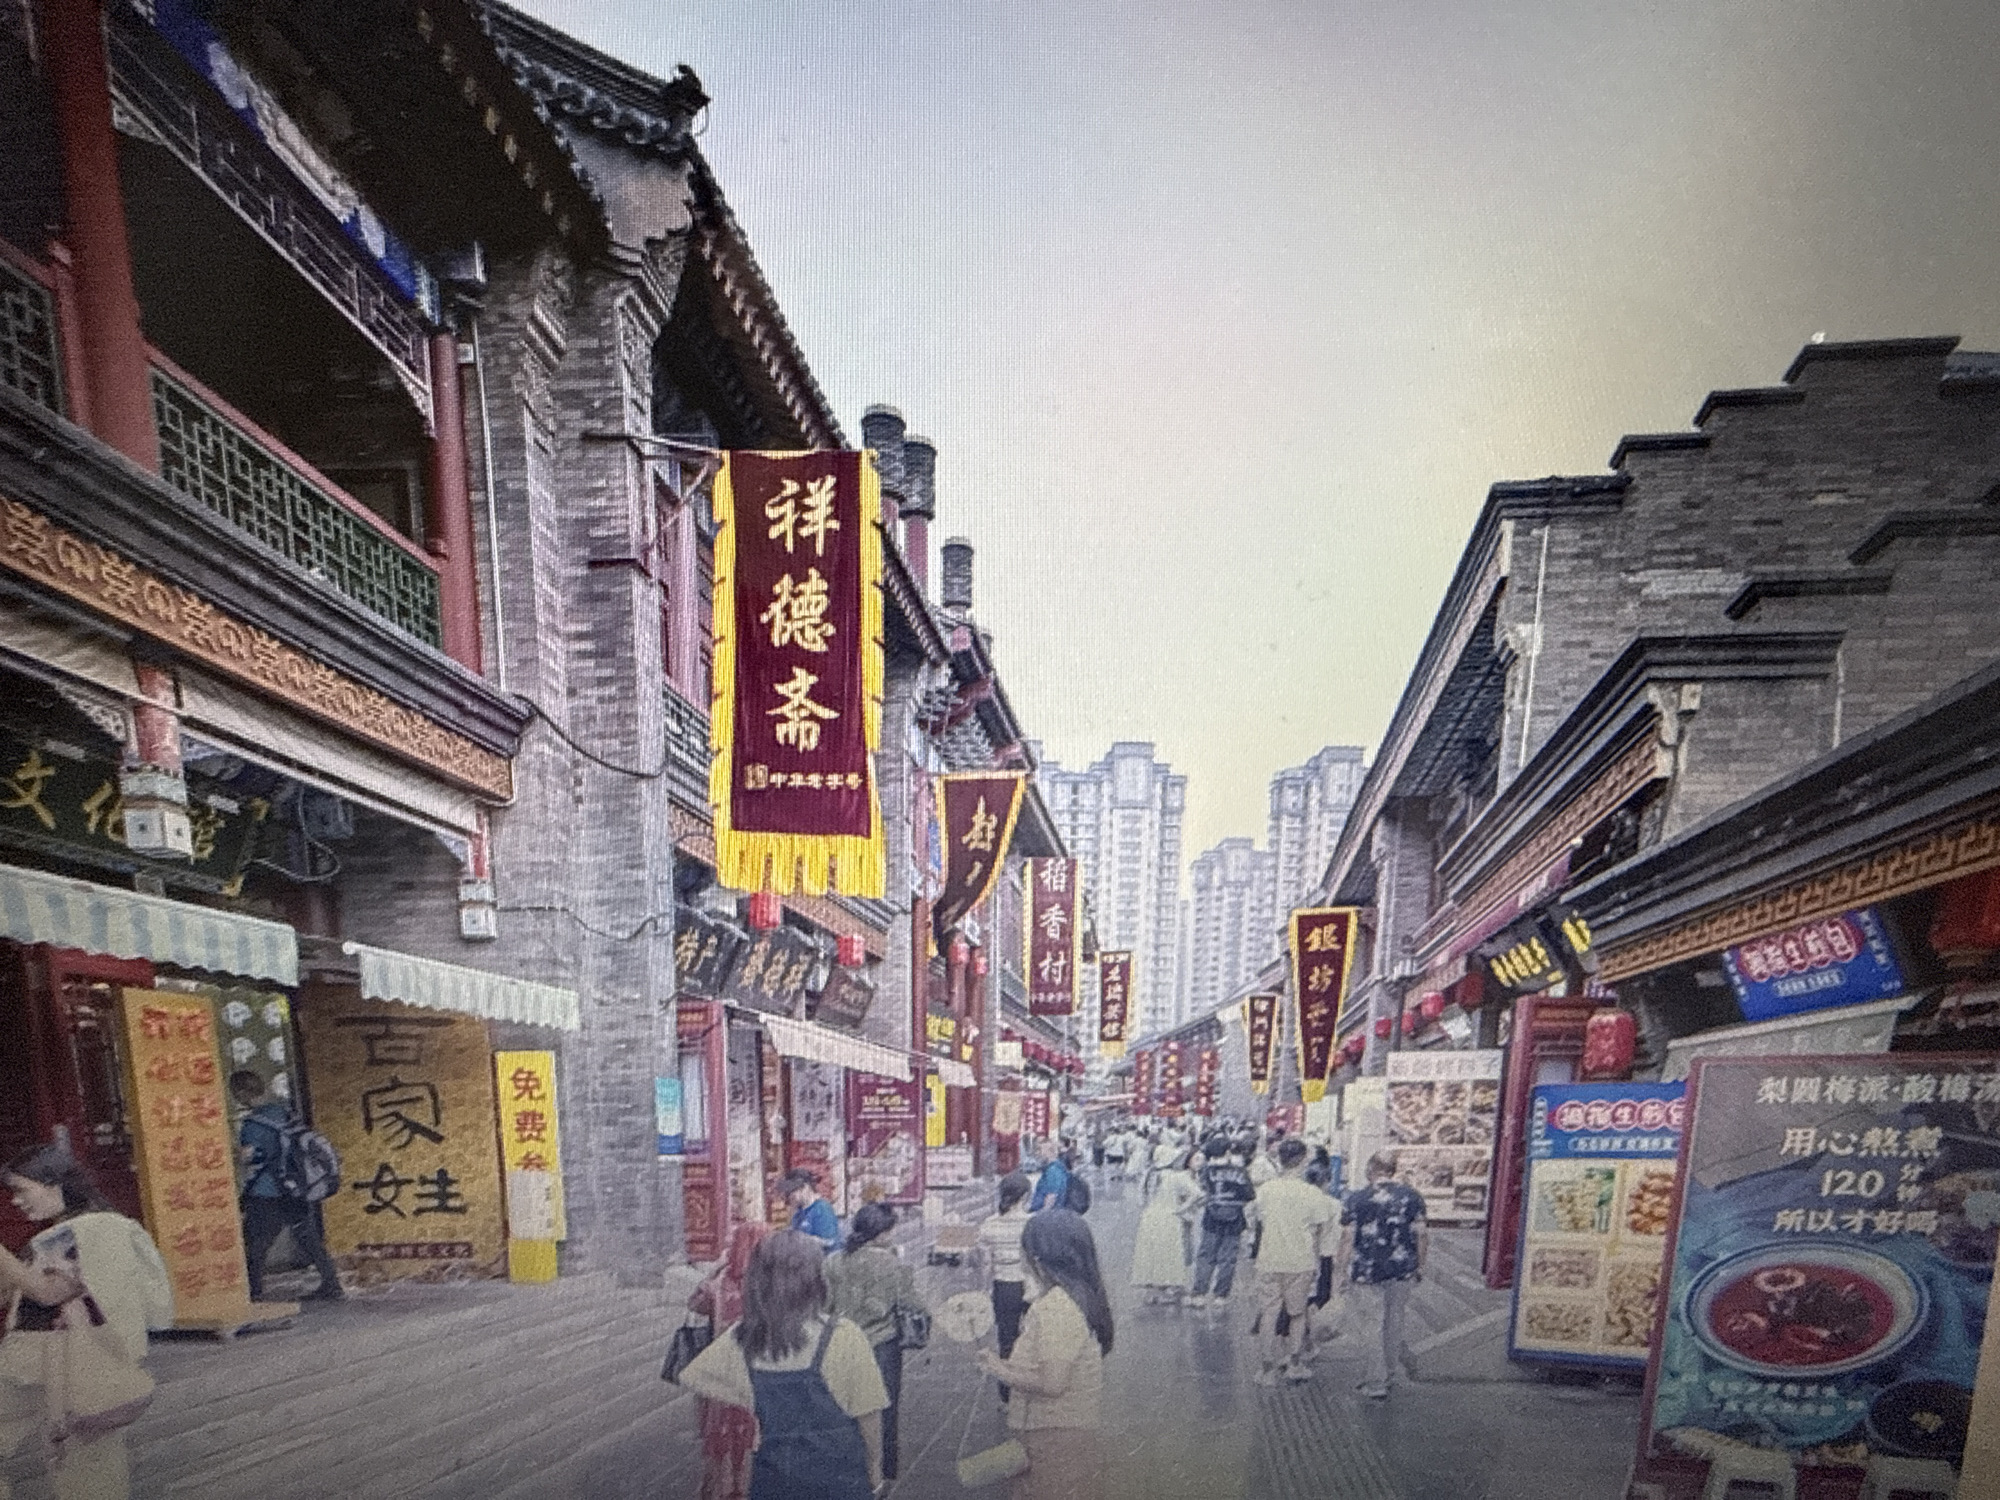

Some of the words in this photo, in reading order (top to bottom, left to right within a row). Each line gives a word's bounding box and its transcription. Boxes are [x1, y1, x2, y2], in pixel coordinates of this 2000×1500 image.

[760, 474, 841, 754] 祥德斋
[1038, 857, 1069, 986] 稻香村
[335, 1014, 468, 1218] 百家姓
[1779, 1126, 1943, 1158] 用心熬煮
[1820, 1169, 1885, 1198] 120
